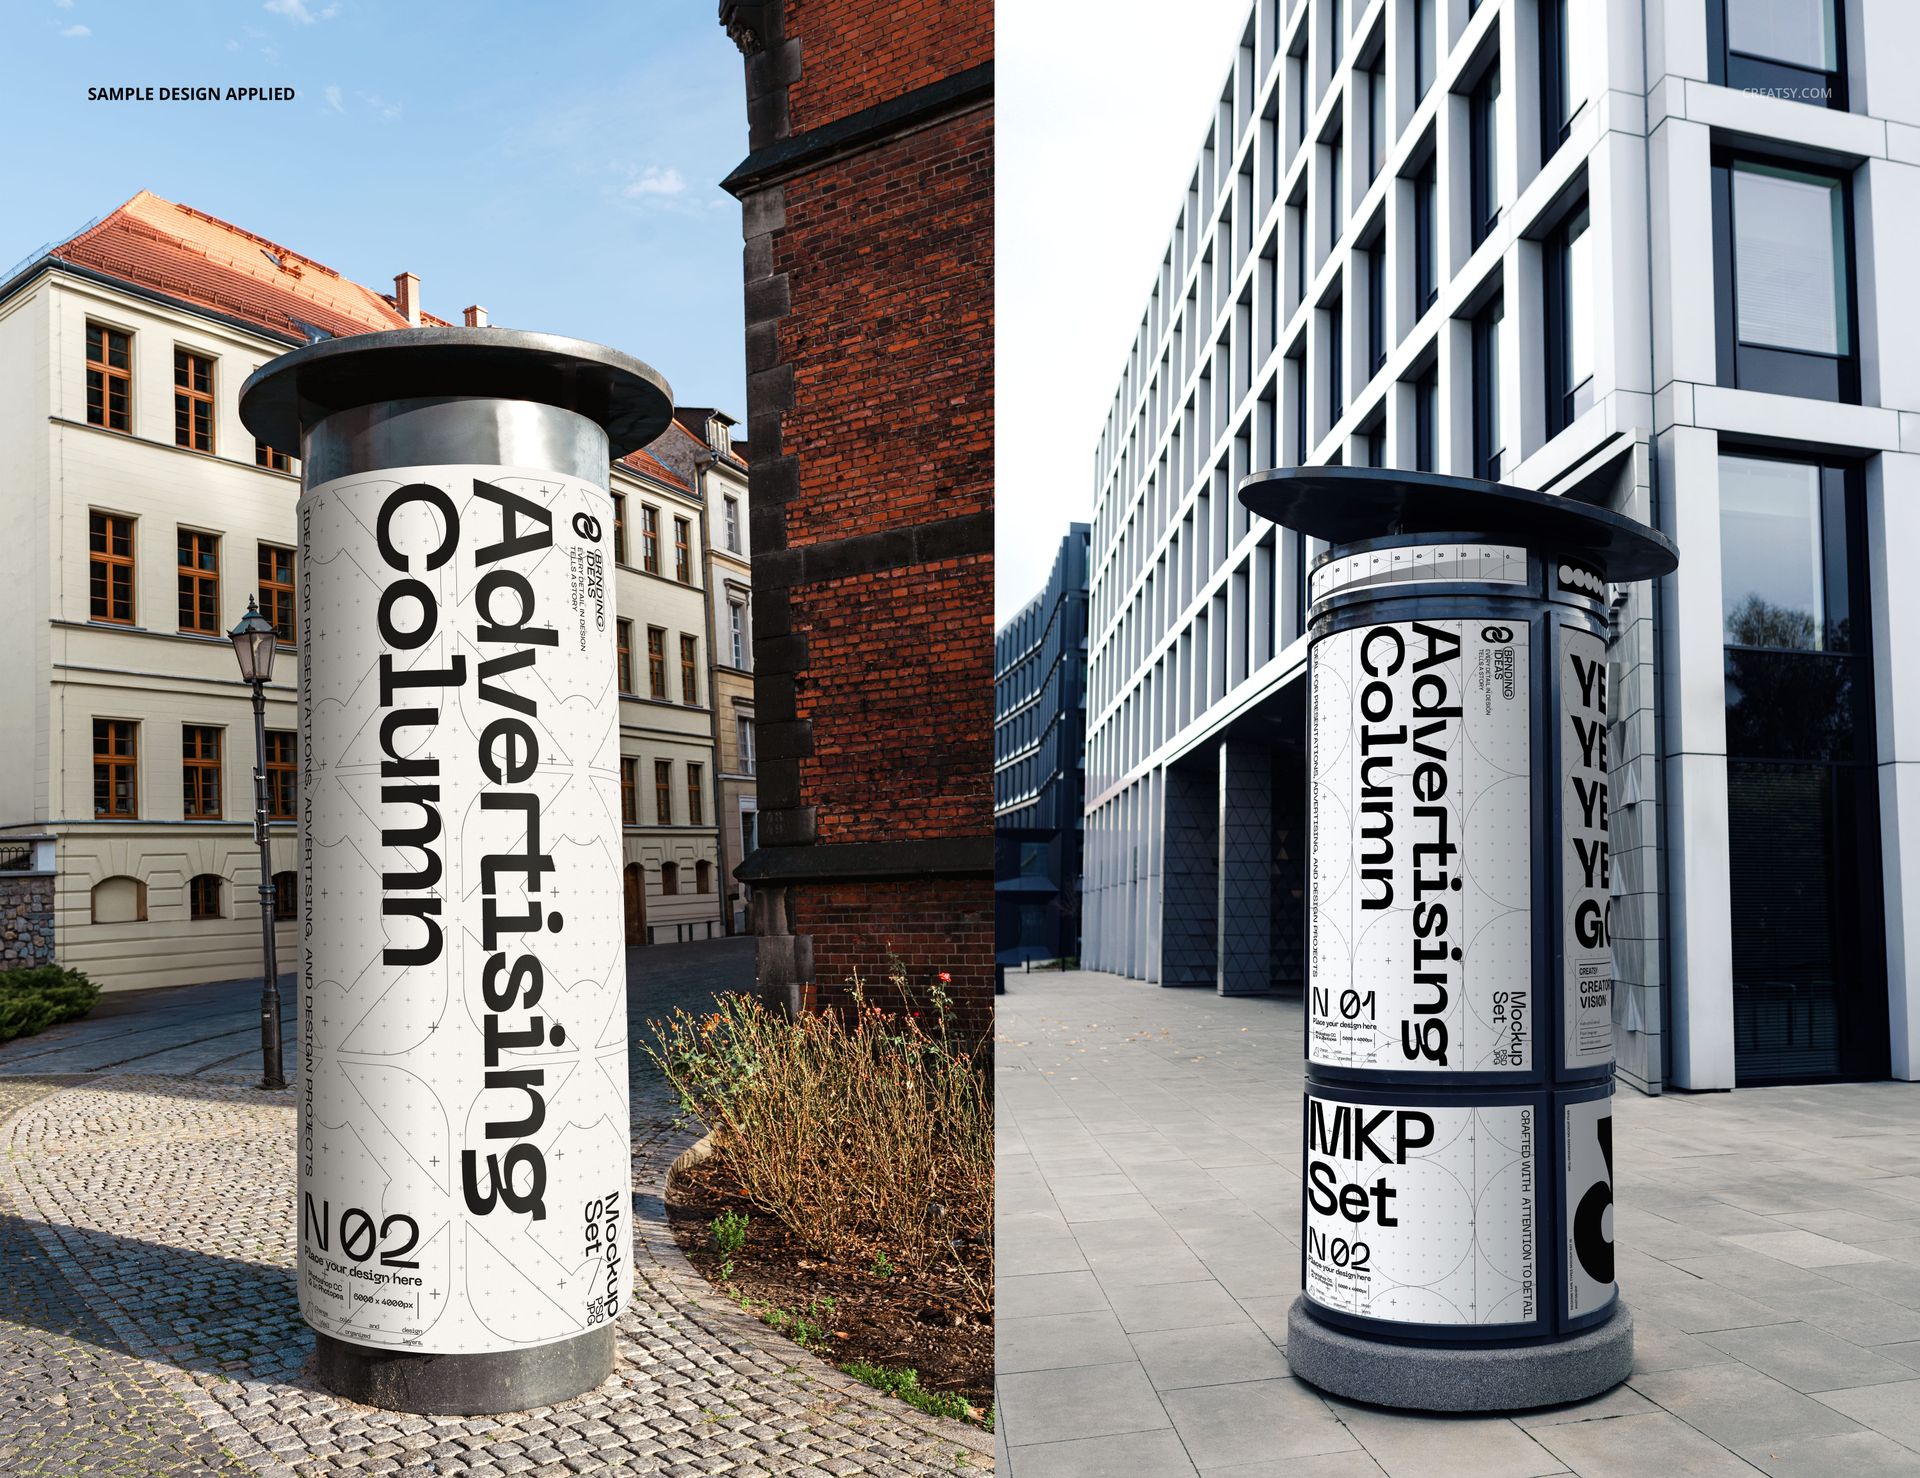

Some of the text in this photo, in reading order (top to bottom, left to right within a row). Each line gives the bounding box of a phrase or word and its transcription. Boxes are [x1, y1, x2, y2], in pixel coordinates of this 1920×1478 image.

[303, 506, 311, 568] IDEAL
[586, 550, 596, 599] IDEAS
[594, 554, 604, 628] BRNDING
[579, 608, 586, 617] IN
[579, 619, 587, 652] DESIGN
[1494, 649, 1503, 680] IDEAS
[1504, 649, 1513, 697] BRNDING
[304, 617, 312, 790] PRESENTATIONS,
[376, 483, 467, 966] Column
[1360, 625, 1407, 910] Column
[462, 478, 565, 1221] Advertising
[1401, 621, 1463, 1066] Advertising
[304, 797, 312, 942] ADVERTISING,
[305, 947, 313, 990] AND
[1313, 986, 1376, 1021] N 01
[1313, 1017, 1326, 1026] Place
[1340, 1021, 1361, 1030] design
[1362, 1022, 1377, 1030] here
[1493, 991, 1509, 1023] Set
[1580, 995, 1607, 1008] VISION
[305, 994, 313, 1073] DESIGN
[1508, 992, 1527, 1066] Mockup
[1493, 1049, 1501, 1065] JPG
[1500, 1049, 1508, 1066] PSD
[305, 1077, 313, 1177] PROJECTS
[1310, 1099, 1435, 1165] MKP
[1308, 1160, 1398, 1227] Set
[1521, 1110, 1533, 1319] CRAFTED WITH ATTENTION TO DETAIL
[305, 1191, 420, 1269] N 02
[585, 1199, 603, 1257] Set
[1309, 1225, 1371, 1273] N 02
[304, 1245, 422, 1286] Place your design here
[604, 1191, 621, 1318] Mockup
[1323, 1265, 1335, 1273] your
[1335, 1269, 1356, 1280] design
[1356, 1273, 1371, 1282] here
[333, 1283, 343, 1292] CC
[353, 1292, 374, 1304] 6000
[381, 1298, 414, 1309] 4000px
[595, 1296, 604, 1324] PSD
[369, 1322, 380, 1330] and
[401, 1326, 423, 1336] design
[587, 1300, 596, 1326] JPG
